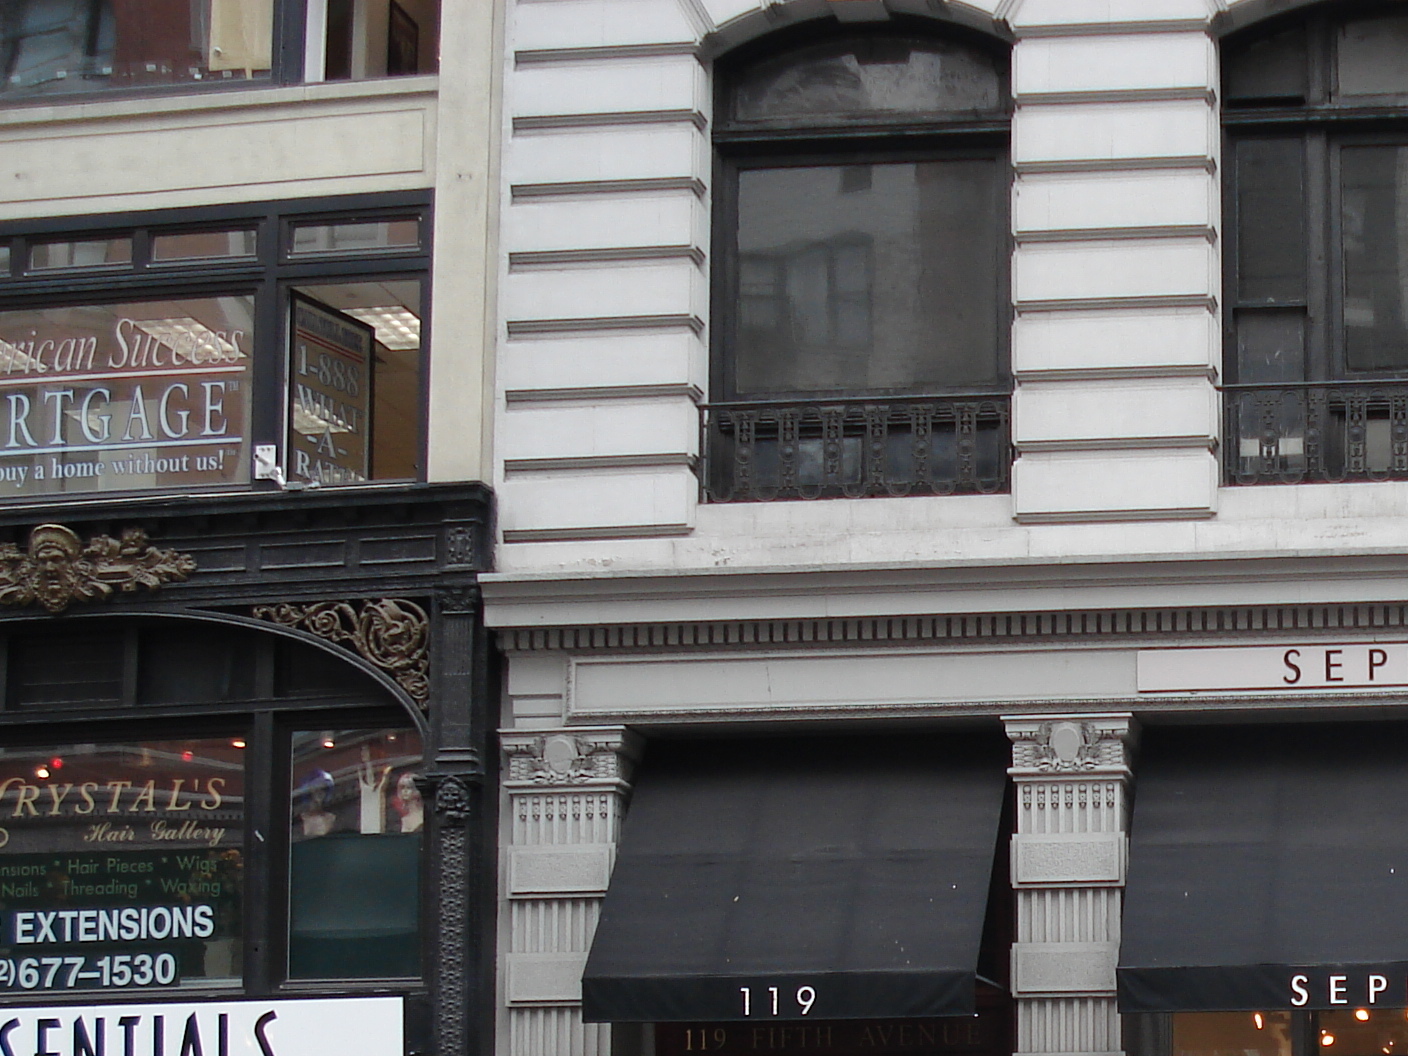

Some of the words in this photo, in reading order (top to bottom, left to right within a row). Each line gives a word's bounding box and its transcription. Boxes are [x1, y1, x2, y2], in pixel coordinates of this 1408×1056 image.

[3, 330, 97, 375] rican
[108, 318, 244, 368] Success
[5, 381, 228, 448] RTGAGE
[34, 465, 45, 480] a
[52, 456, 106, 479] home
[111, 453, 190, 475] without
[196, 449, 224, 471] us!
[84, 822, 136, 842] Hair
[150, 820, 226, 847] Gallery
[68, 858, 99, 875] Hair
[106, 857, 154, 873] Pieces
[176, 855, 217, 876] Wigs
[1, 881, 40, 898] Nails
[63, 878, 138, 897] Threading
[161, 877, 221, 897] Waxing
[16, 905, 214, 944] EXTENSIONS
[740, 986, 816, 1016] 119
[685, 1027, 727, 1051] 119
[752, 1026, 834, 1048] FIFTH
[858, 1022, 983, 1046] AVENUE
